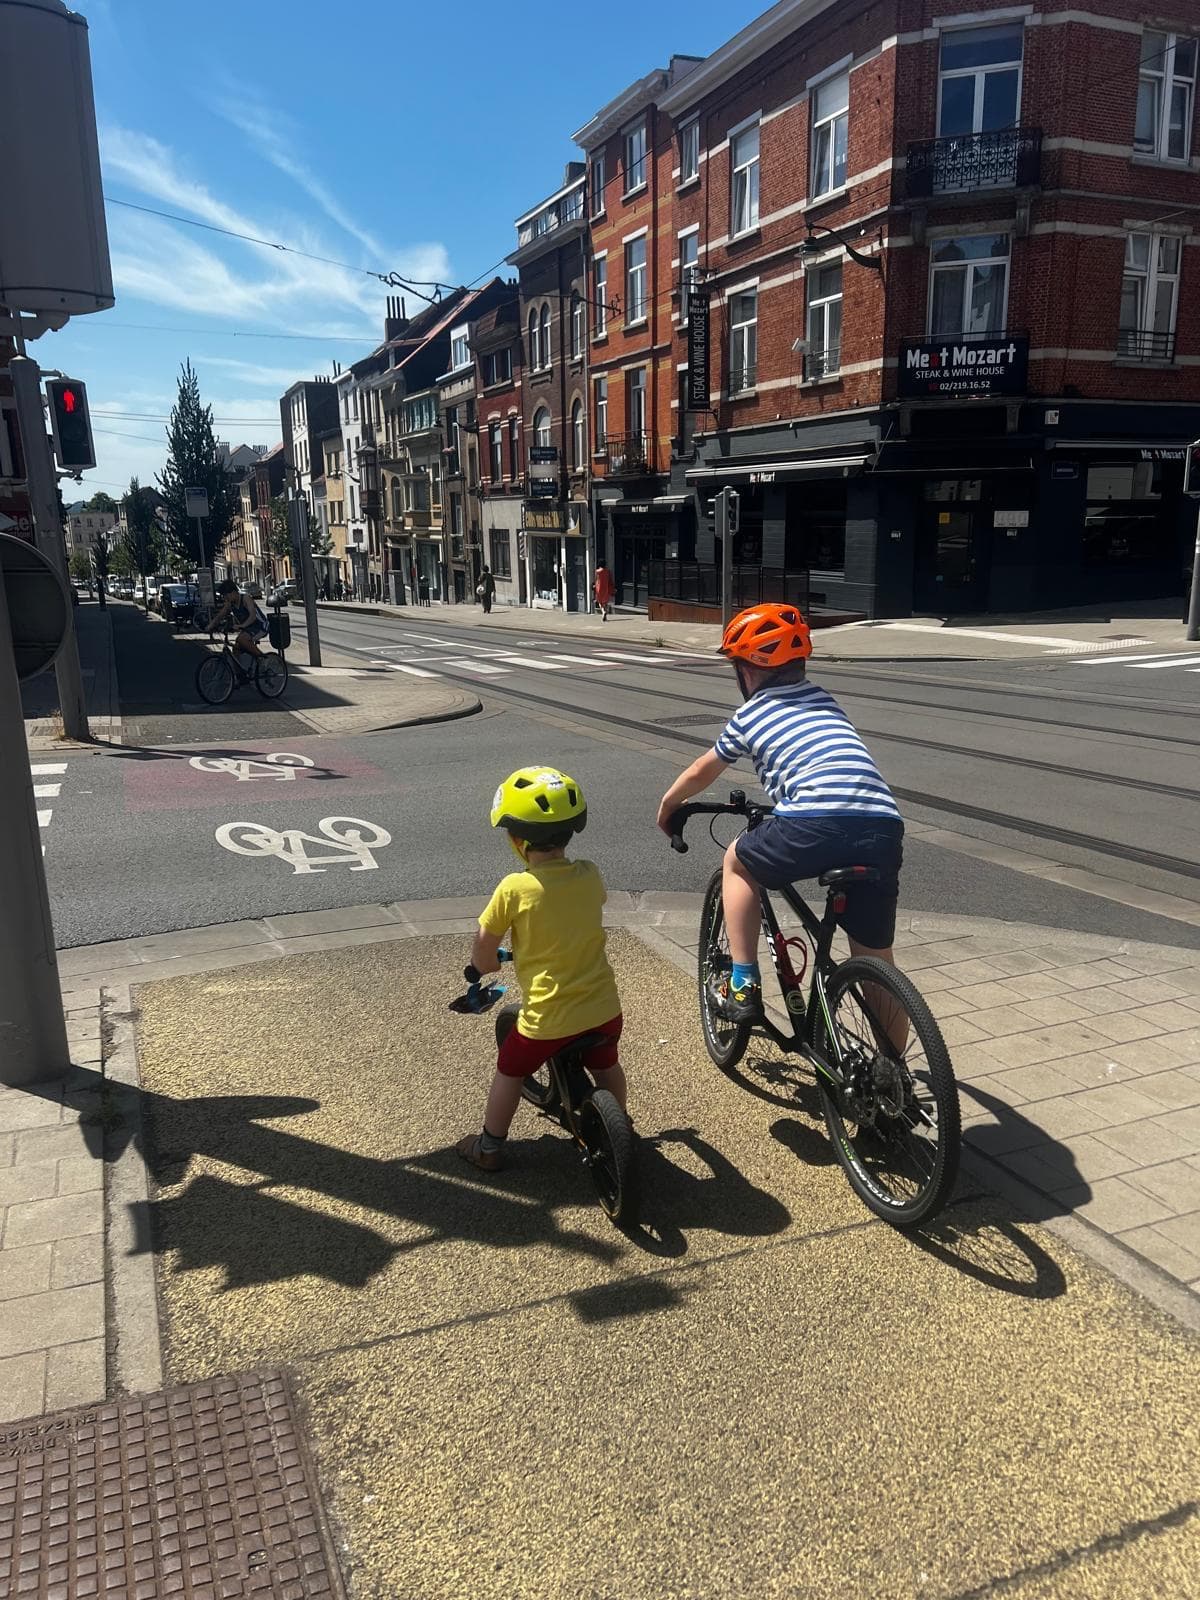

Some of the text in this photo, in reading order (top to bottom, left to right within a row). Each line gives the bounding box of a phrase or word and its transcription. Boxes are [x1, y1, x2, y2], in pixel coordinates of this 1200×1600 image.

[693, 315, 705, 343] HOUSE
[693, 345, 705, 366] WINE
[952, 343, 1016, 366] Mozart
[915, 366, 1005, 379] STEAK & WINE HOUSE
[693, 376, 705, 399] STEAK
[939, 381, 991, 391] 02/219.16.52
